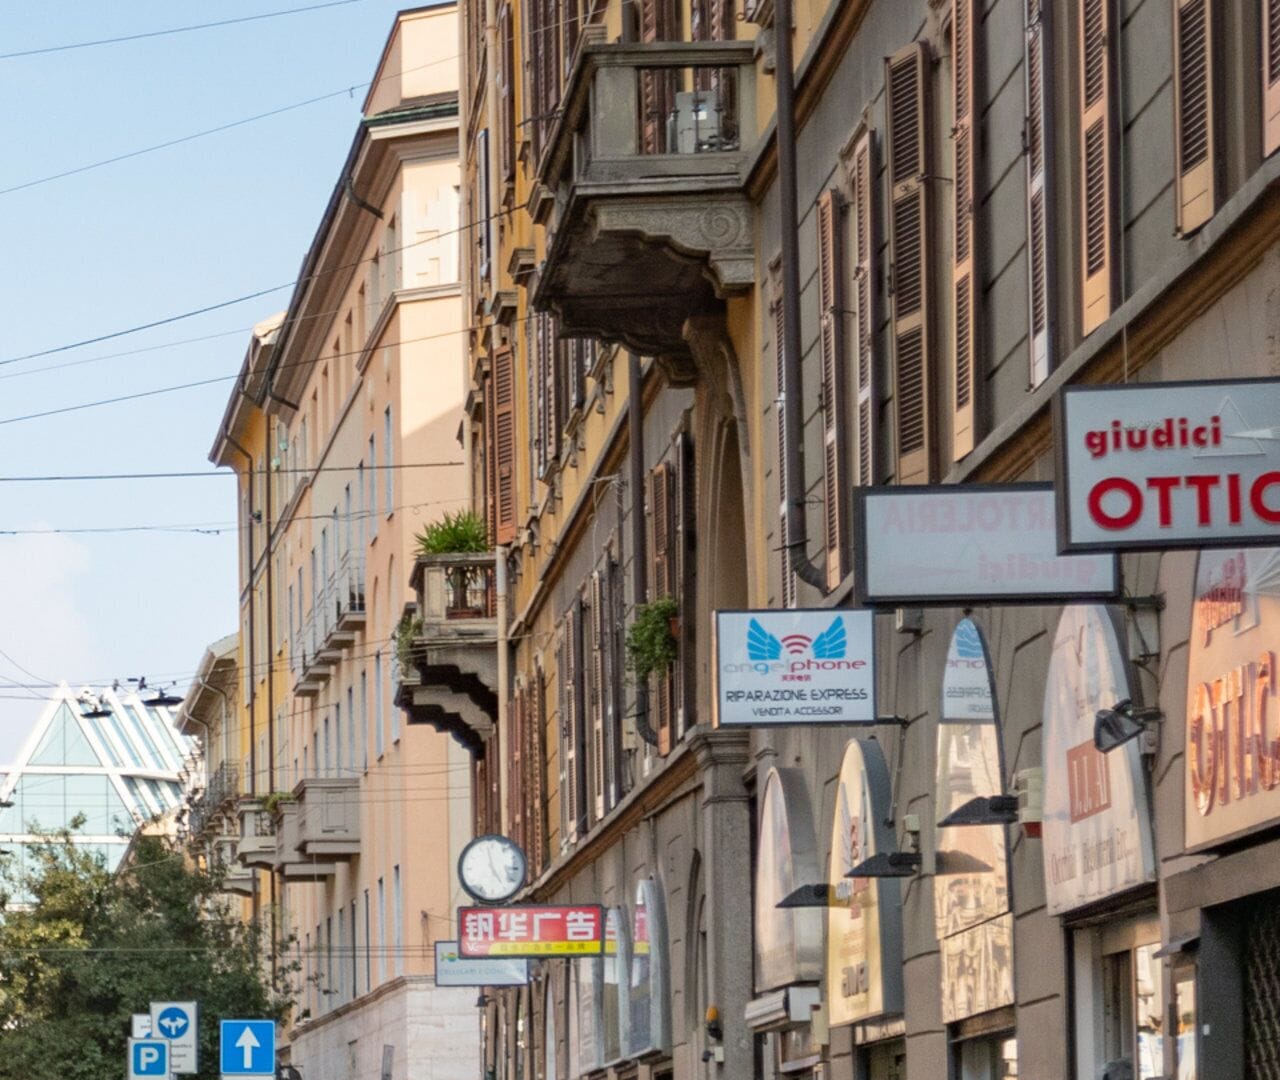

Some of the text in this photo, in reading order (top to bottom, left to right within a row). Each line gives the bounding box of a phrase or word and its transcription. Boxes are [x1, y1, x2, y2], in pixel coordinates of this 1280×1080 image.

[1085, 415, 1222, 458] giudici
[725, 688, 868, 703] RIPARAZIONE EXPRESS
[752, 706, 791, 717] VENDITA
[140, 1047, 159, 1072] P
